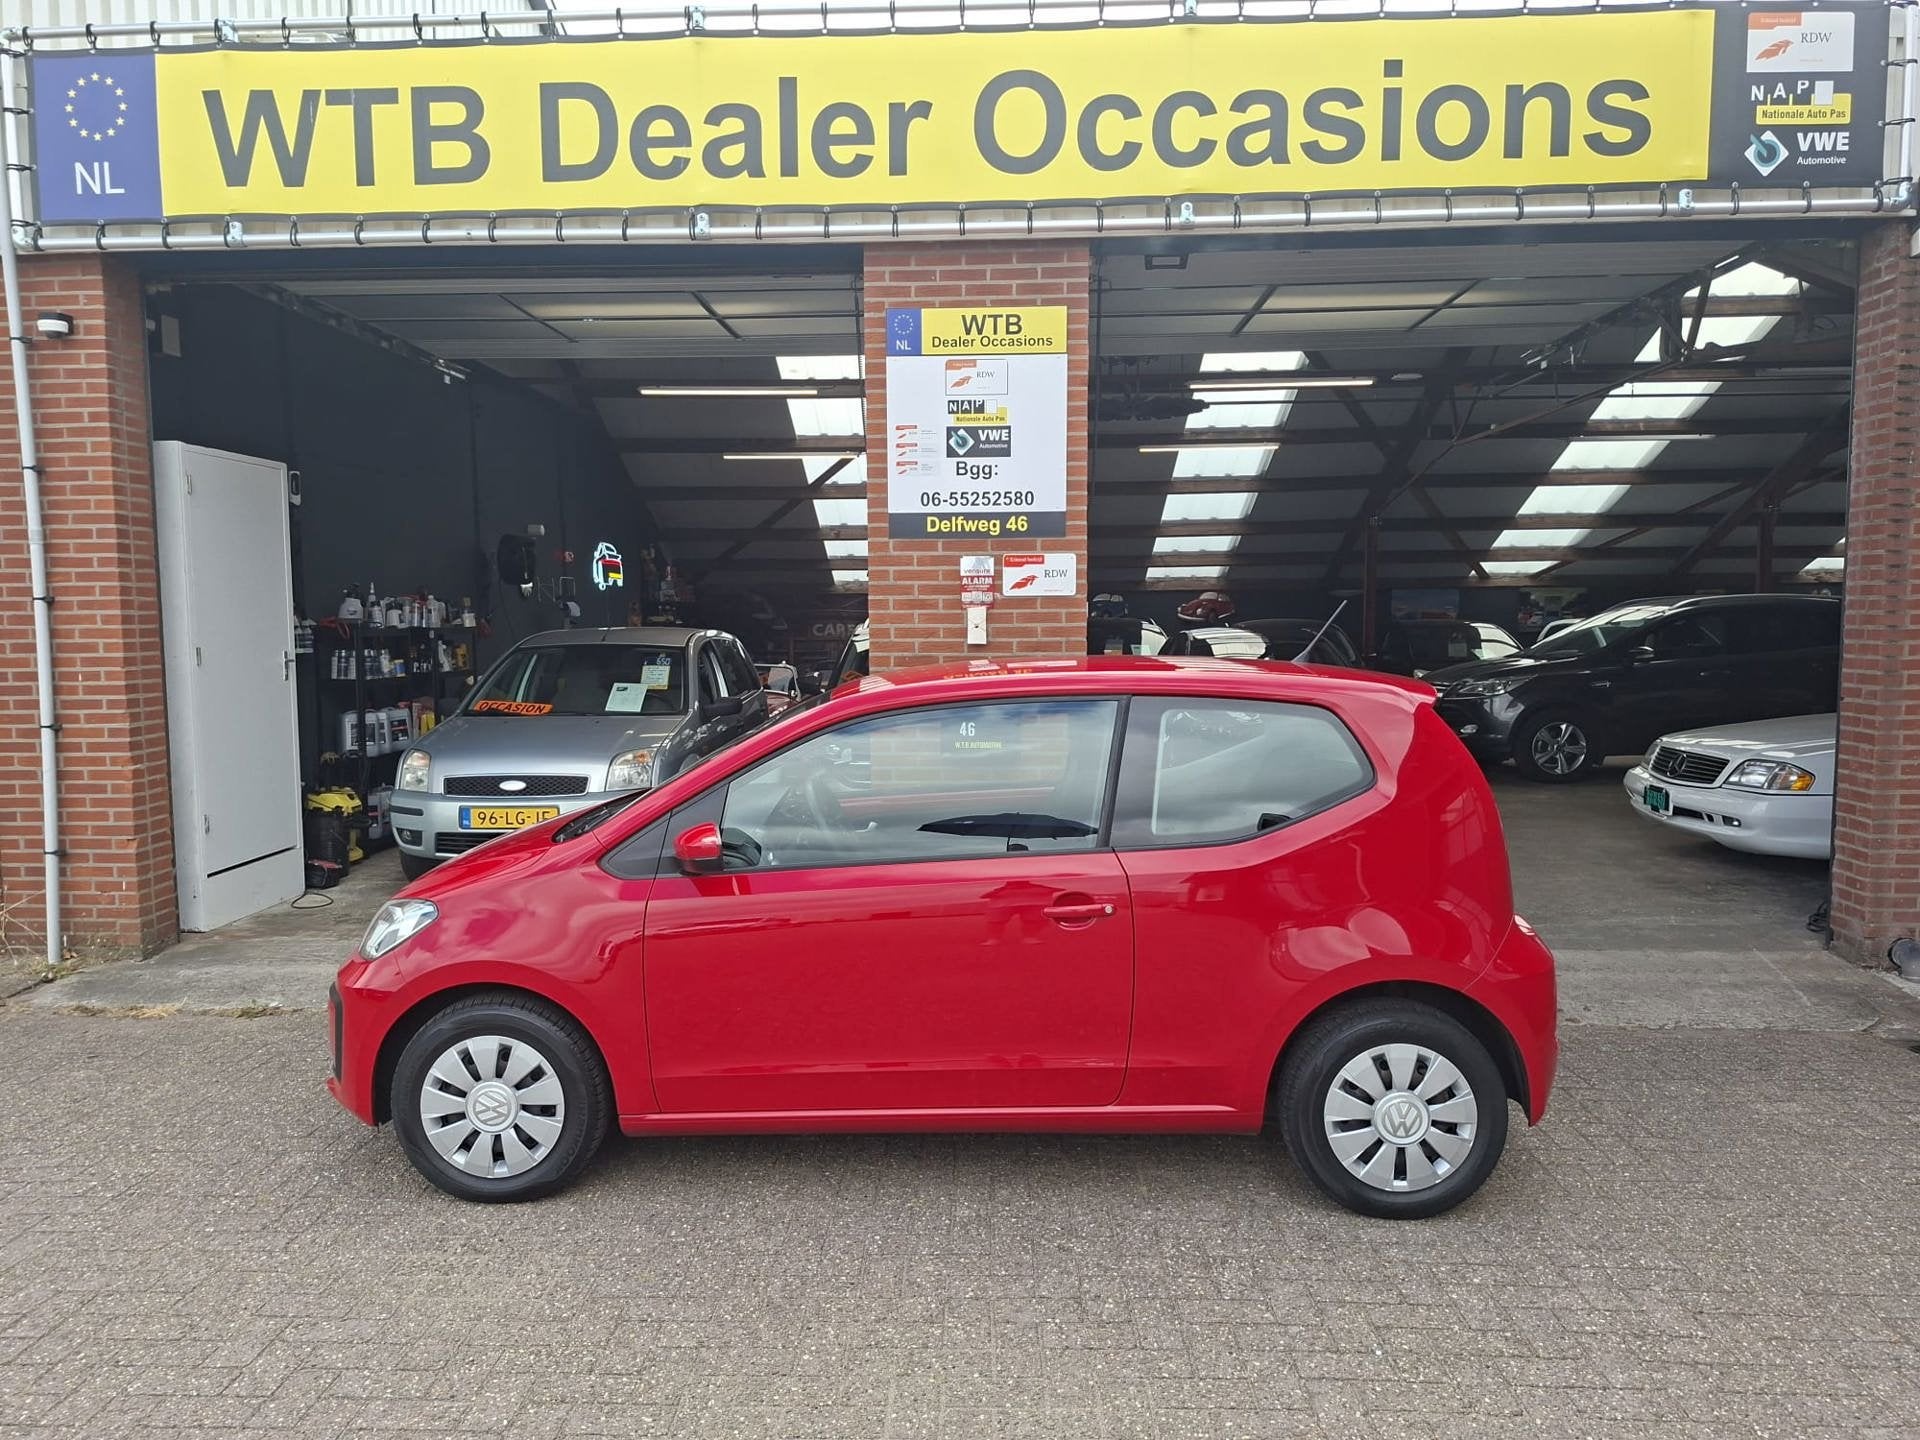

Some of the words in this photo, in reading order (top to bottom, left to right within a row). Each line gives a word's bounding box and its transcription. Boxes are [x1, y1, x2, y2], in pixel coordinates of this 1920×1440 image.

[1801, 32, 1832, 43] RDW
[1762, 109, 1804, 119] Nationale
[1807, 109, 1827, 119] Auto
[1830, 108, 1846, 118] Pas
[202, 86, 490, 187] WTB
[539, 77, 933, 182] Dealer
[973, 59, 1651, 174] Occasions
[1797, 131, 1850, 151] VWE
[1797, 155, 1847, 165] Automotive
[74, 161, 125, 195] NL
[961, 314, 1023, 335] WTB
[896, 340, 911, 350] NL
[932, 336, 976, 348] Dealer
[980, 335, 1053, 347] Occasions
[978, 429, 1010, 441] VWE
[956, 461, 998, 479] Bgg:
[921, 491, 1034, 507] 06-55252580
[926, 515, 1000, 535] Delfweg
[1006, 515, 1028, 532] 46
[1044, 569, 1068, 578] RDW
[962, 577, 993, 585] ALARM
[960, 722, 976, 736] 46
